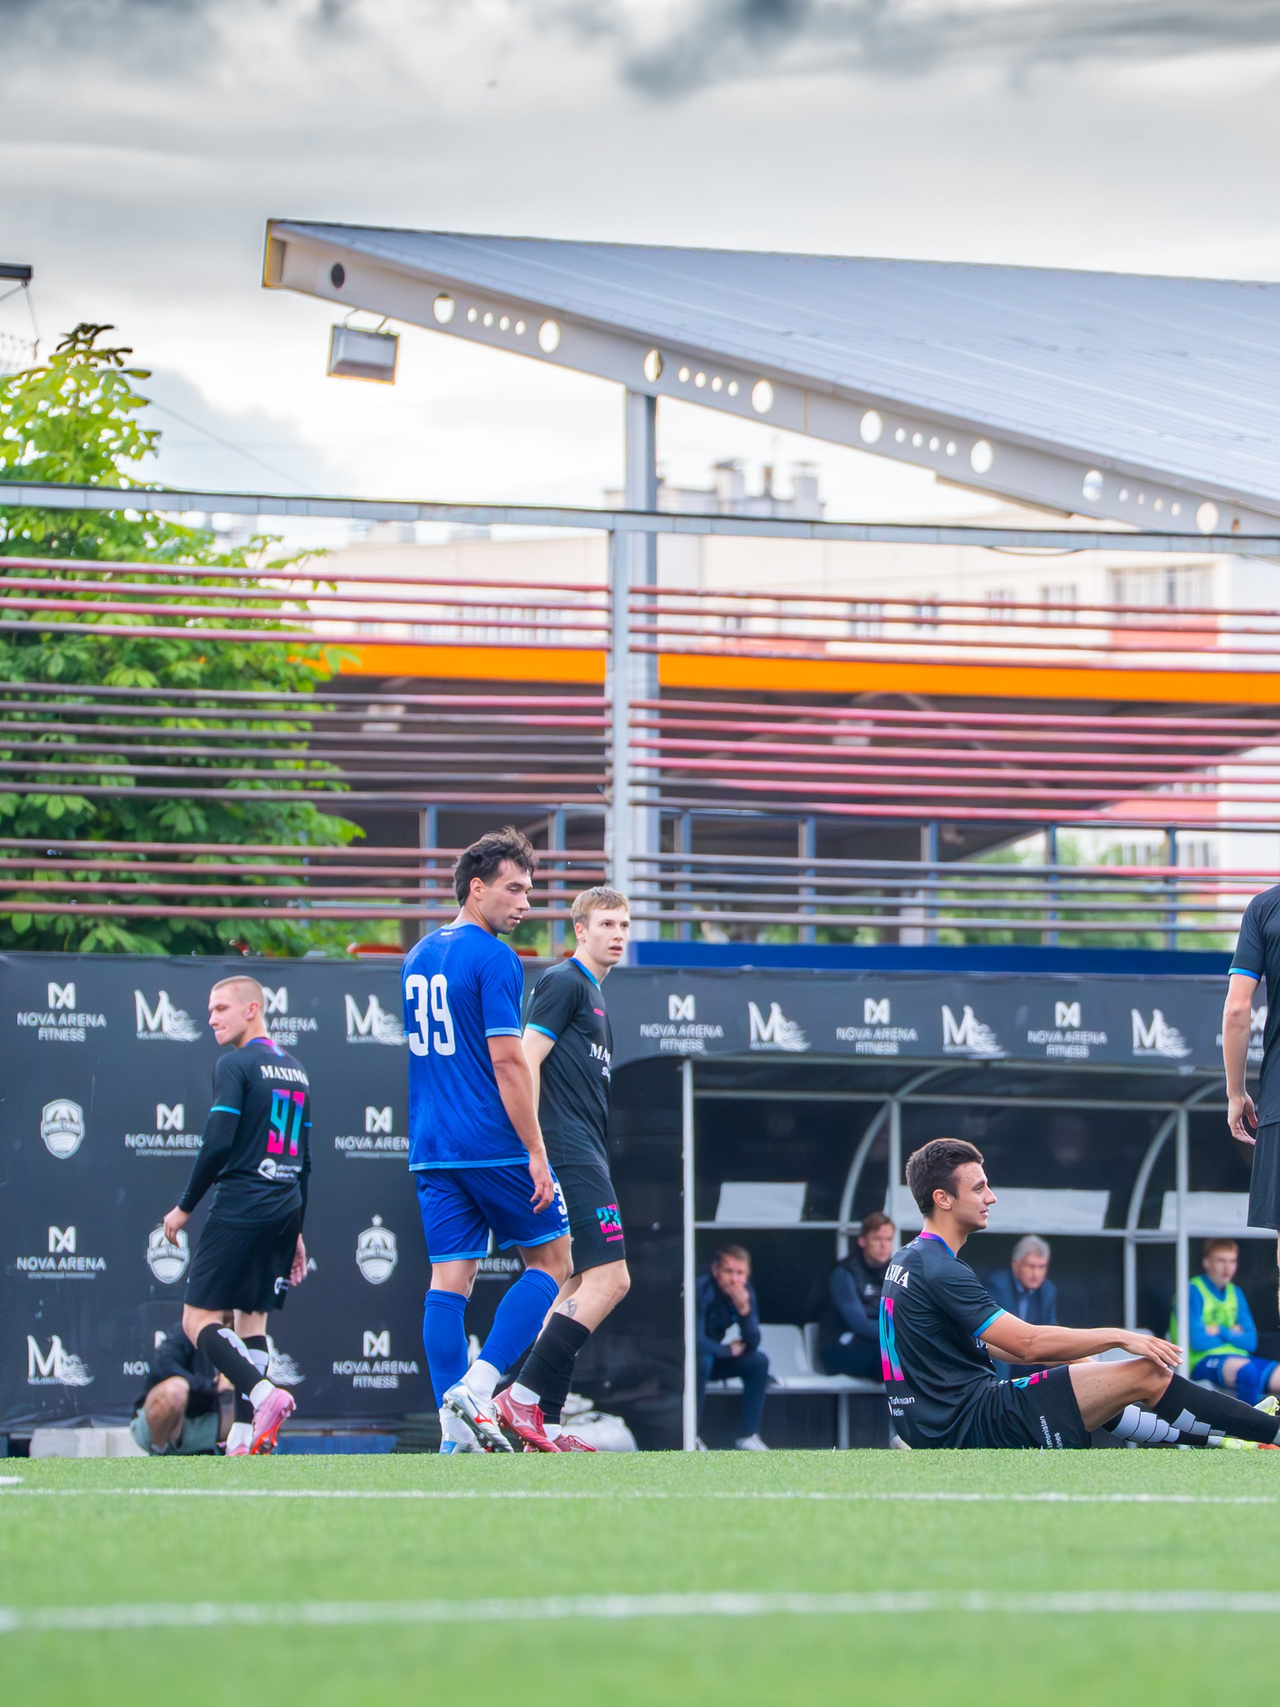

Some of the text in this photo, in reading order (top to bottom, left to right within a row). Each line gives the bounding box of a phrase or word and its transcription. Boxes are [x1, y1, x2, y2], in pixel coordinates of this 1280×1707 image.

[17, 1012, 107, 1028] NOVA ARENA
[405, 974, 456, 1056] 39
[270, 1017, 319, 1031] ARENA
[640, 1024, 724, 1039] NOVA ARENA
[38, 1028, 86, 1042] FITNESS
[836, 1026, 918, 1042] NOVA ARENA
[1027, 1030, 1107, 1045] NOVA ARENA
[660, 1038, 704, 1051] FITNESS
[855, 1041, 899, 1055] FITNESS
[1046, 1044, 1090, 1058] FITNESS
[267, 1088, 305, 1156] 91
[125, 1133, 204, 1148] NOVA AREN
[335, 1136, 409, 1150] NOVA AREN
[596, 1203, 622, 1234] 23
[17, 1256, 107, 1271] NOVA ARENA
[333, 1360, 419, 1375] NOVA ARENA
[353, 1375, 399, 1389] FITNESS
